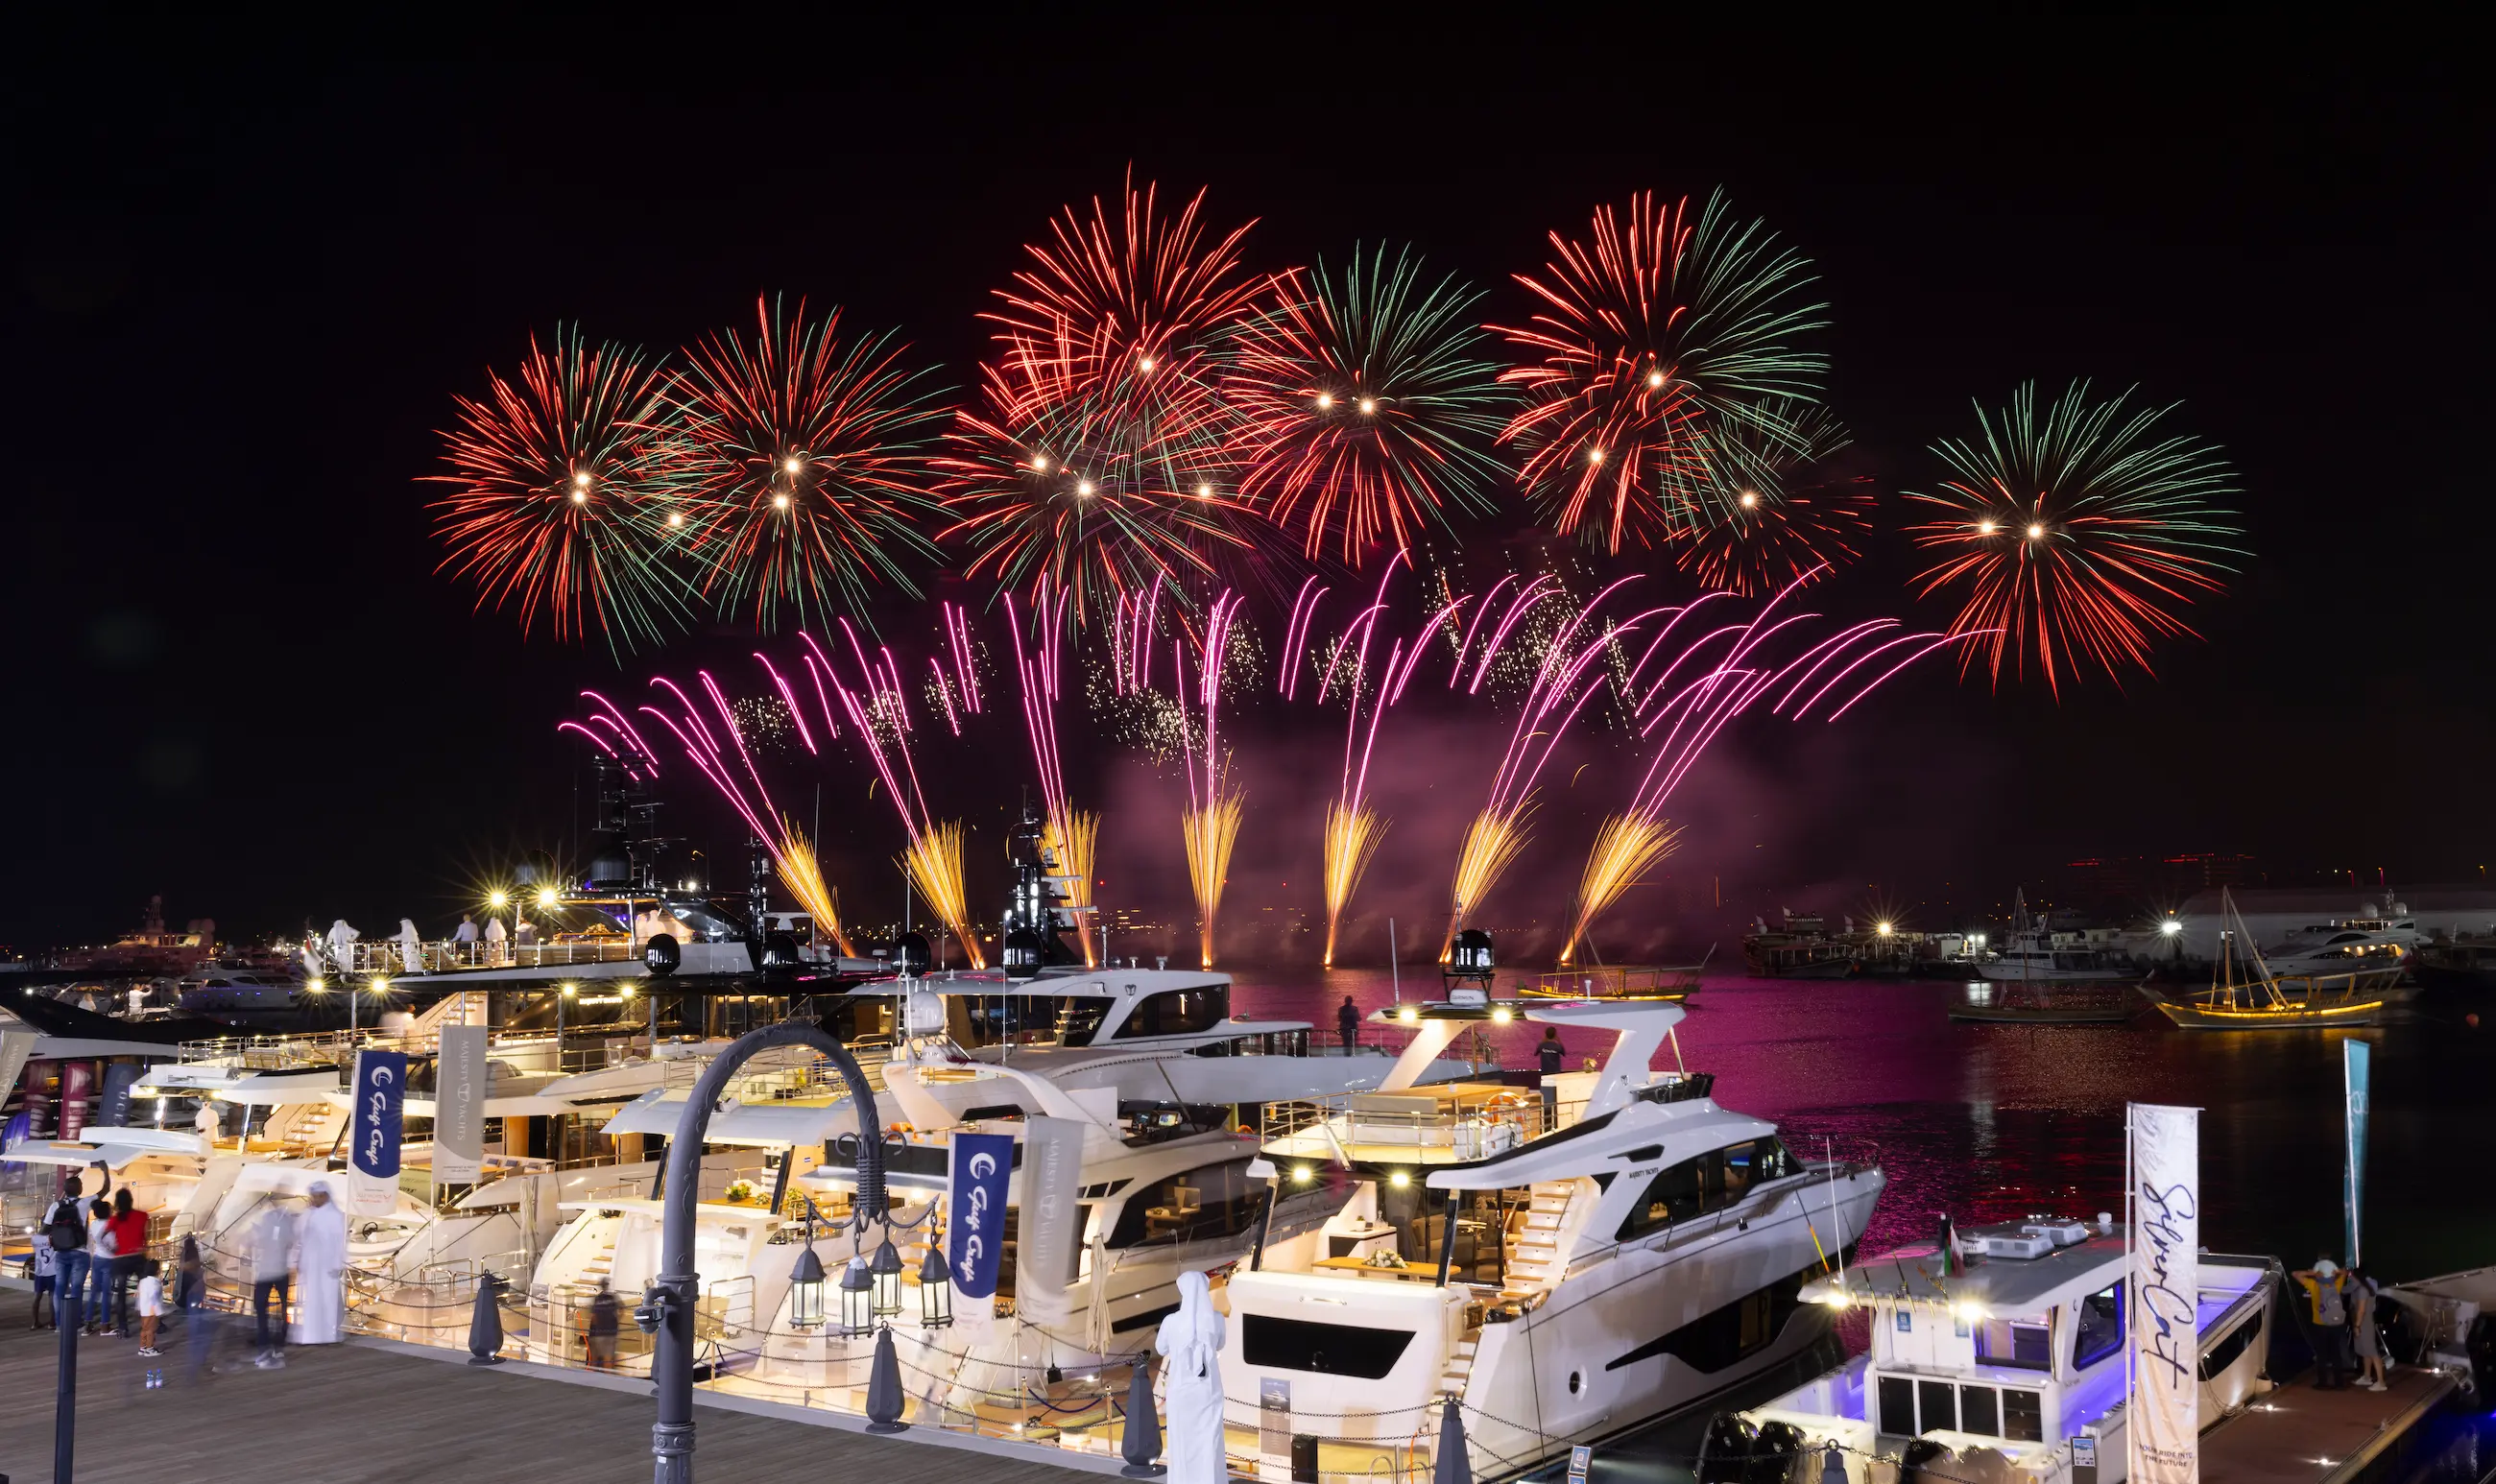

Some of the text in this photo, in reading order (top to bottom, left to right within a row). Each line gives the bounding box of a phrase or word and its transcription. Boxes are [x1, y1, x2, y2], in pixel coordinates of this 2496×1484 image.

[457, 1040, 470, 1141] MAJESTY YACHTS
[365, 1091, 386, 1166] Gulf Craft
[960, 1185, 988, 1282] Gulf Craft
[40, 1249, 51, 1264] 5
[2145, 1454, 2188, 1468] THE FUTURE
[2158, 1449, 2176, 1458] RIDE
